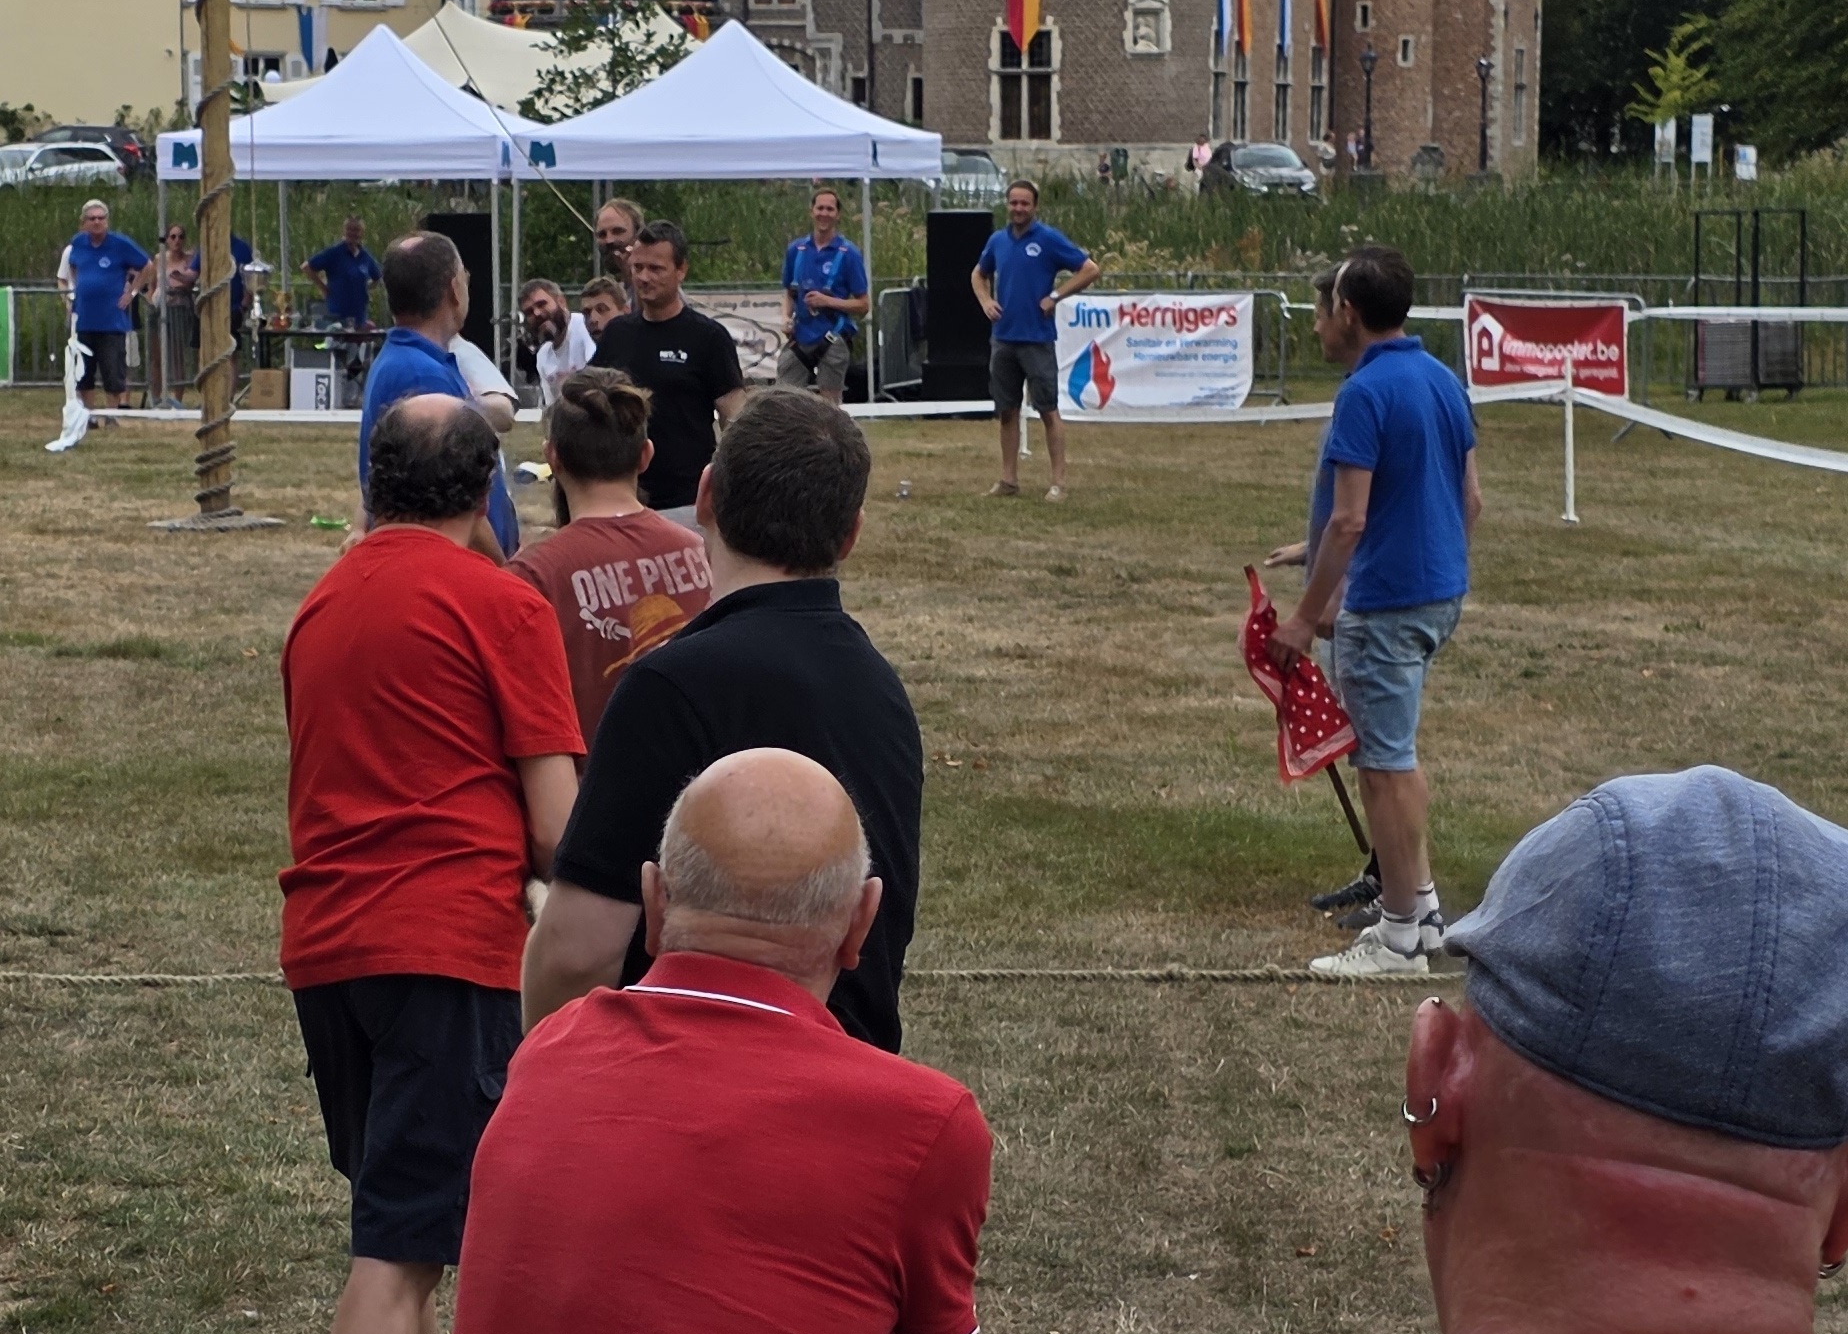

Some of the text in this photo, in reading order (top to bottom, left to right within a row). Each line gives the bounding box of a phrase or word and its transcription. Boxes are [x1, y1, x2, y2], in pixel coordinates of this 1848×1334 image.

[1068, 300, 1238, 333] Jim Herrijgers
[571, 545, 713, 613] ONE PIEC
